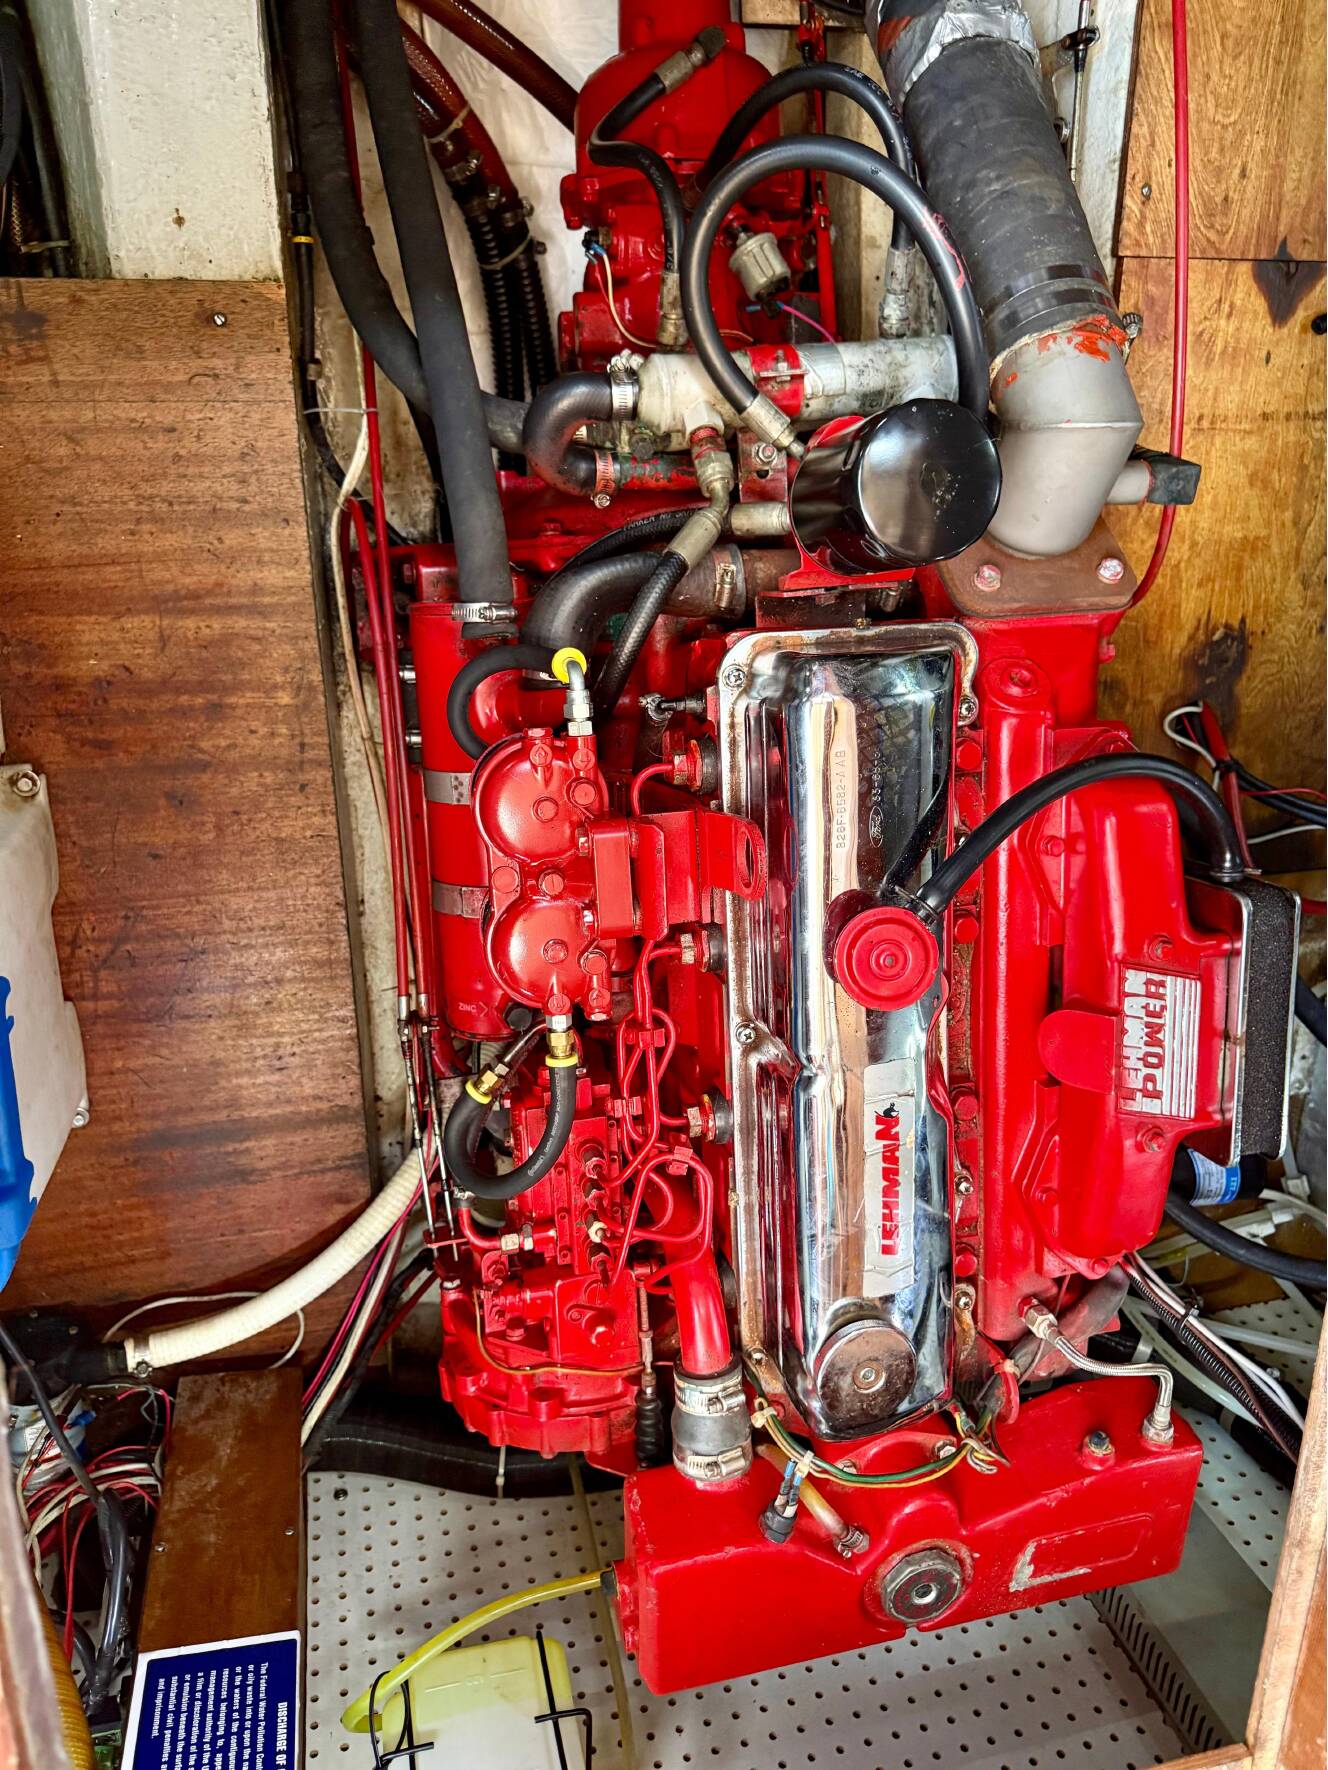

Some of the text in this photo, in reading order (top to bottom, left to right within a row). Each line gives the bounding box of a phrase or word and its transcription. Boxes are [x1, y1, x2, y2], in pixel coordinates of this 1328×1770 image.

[458, 1002, 477, 1012] ZINC
[1119, 968, 1147, 1112] LEHMAN
[1142, 977, 1167, 1099] POWER
[874, 1114, 900, 1256] LEHMAN
[246, 1673, 255, 1684] oily
[260, 1662, 268, 1674] The
[168, 1676, 178, 1710] substantial
[196, 1678, 204, 1690] film
[207, 1670, 216, 1711] management
[221, 1668, 229, 1698] resources
[259, 1675, 267, 1699] Federal
[181, 1683, 189, 1711] emulsion
[152, 1691, 165, 1738] imprisonment.
[166, 1713, 174, 1727] civil
[178, 1713, 188, 1739] beneath
[191, 1701, 202, 1743] discoloration
[217, 1702, 227, 1735] belonging
[245, 1707, 253, 1719] into
[276, 1702, 288, 1751] DISCHARGE
[203, 1713, 213, 1741] authority
[243, 1730, 251, 1746] upon
[257, 1722, 265, 1751] Pollution
[162, 1730, 172, 1761] penalties
[177, 1741, 185, 1752] the
[202, 1752, 210, 1763] the
[243, 1748, 251, 1759] the
[189, 1754, 197, 1765] the
[276, 1754, 286, 1765] OF
